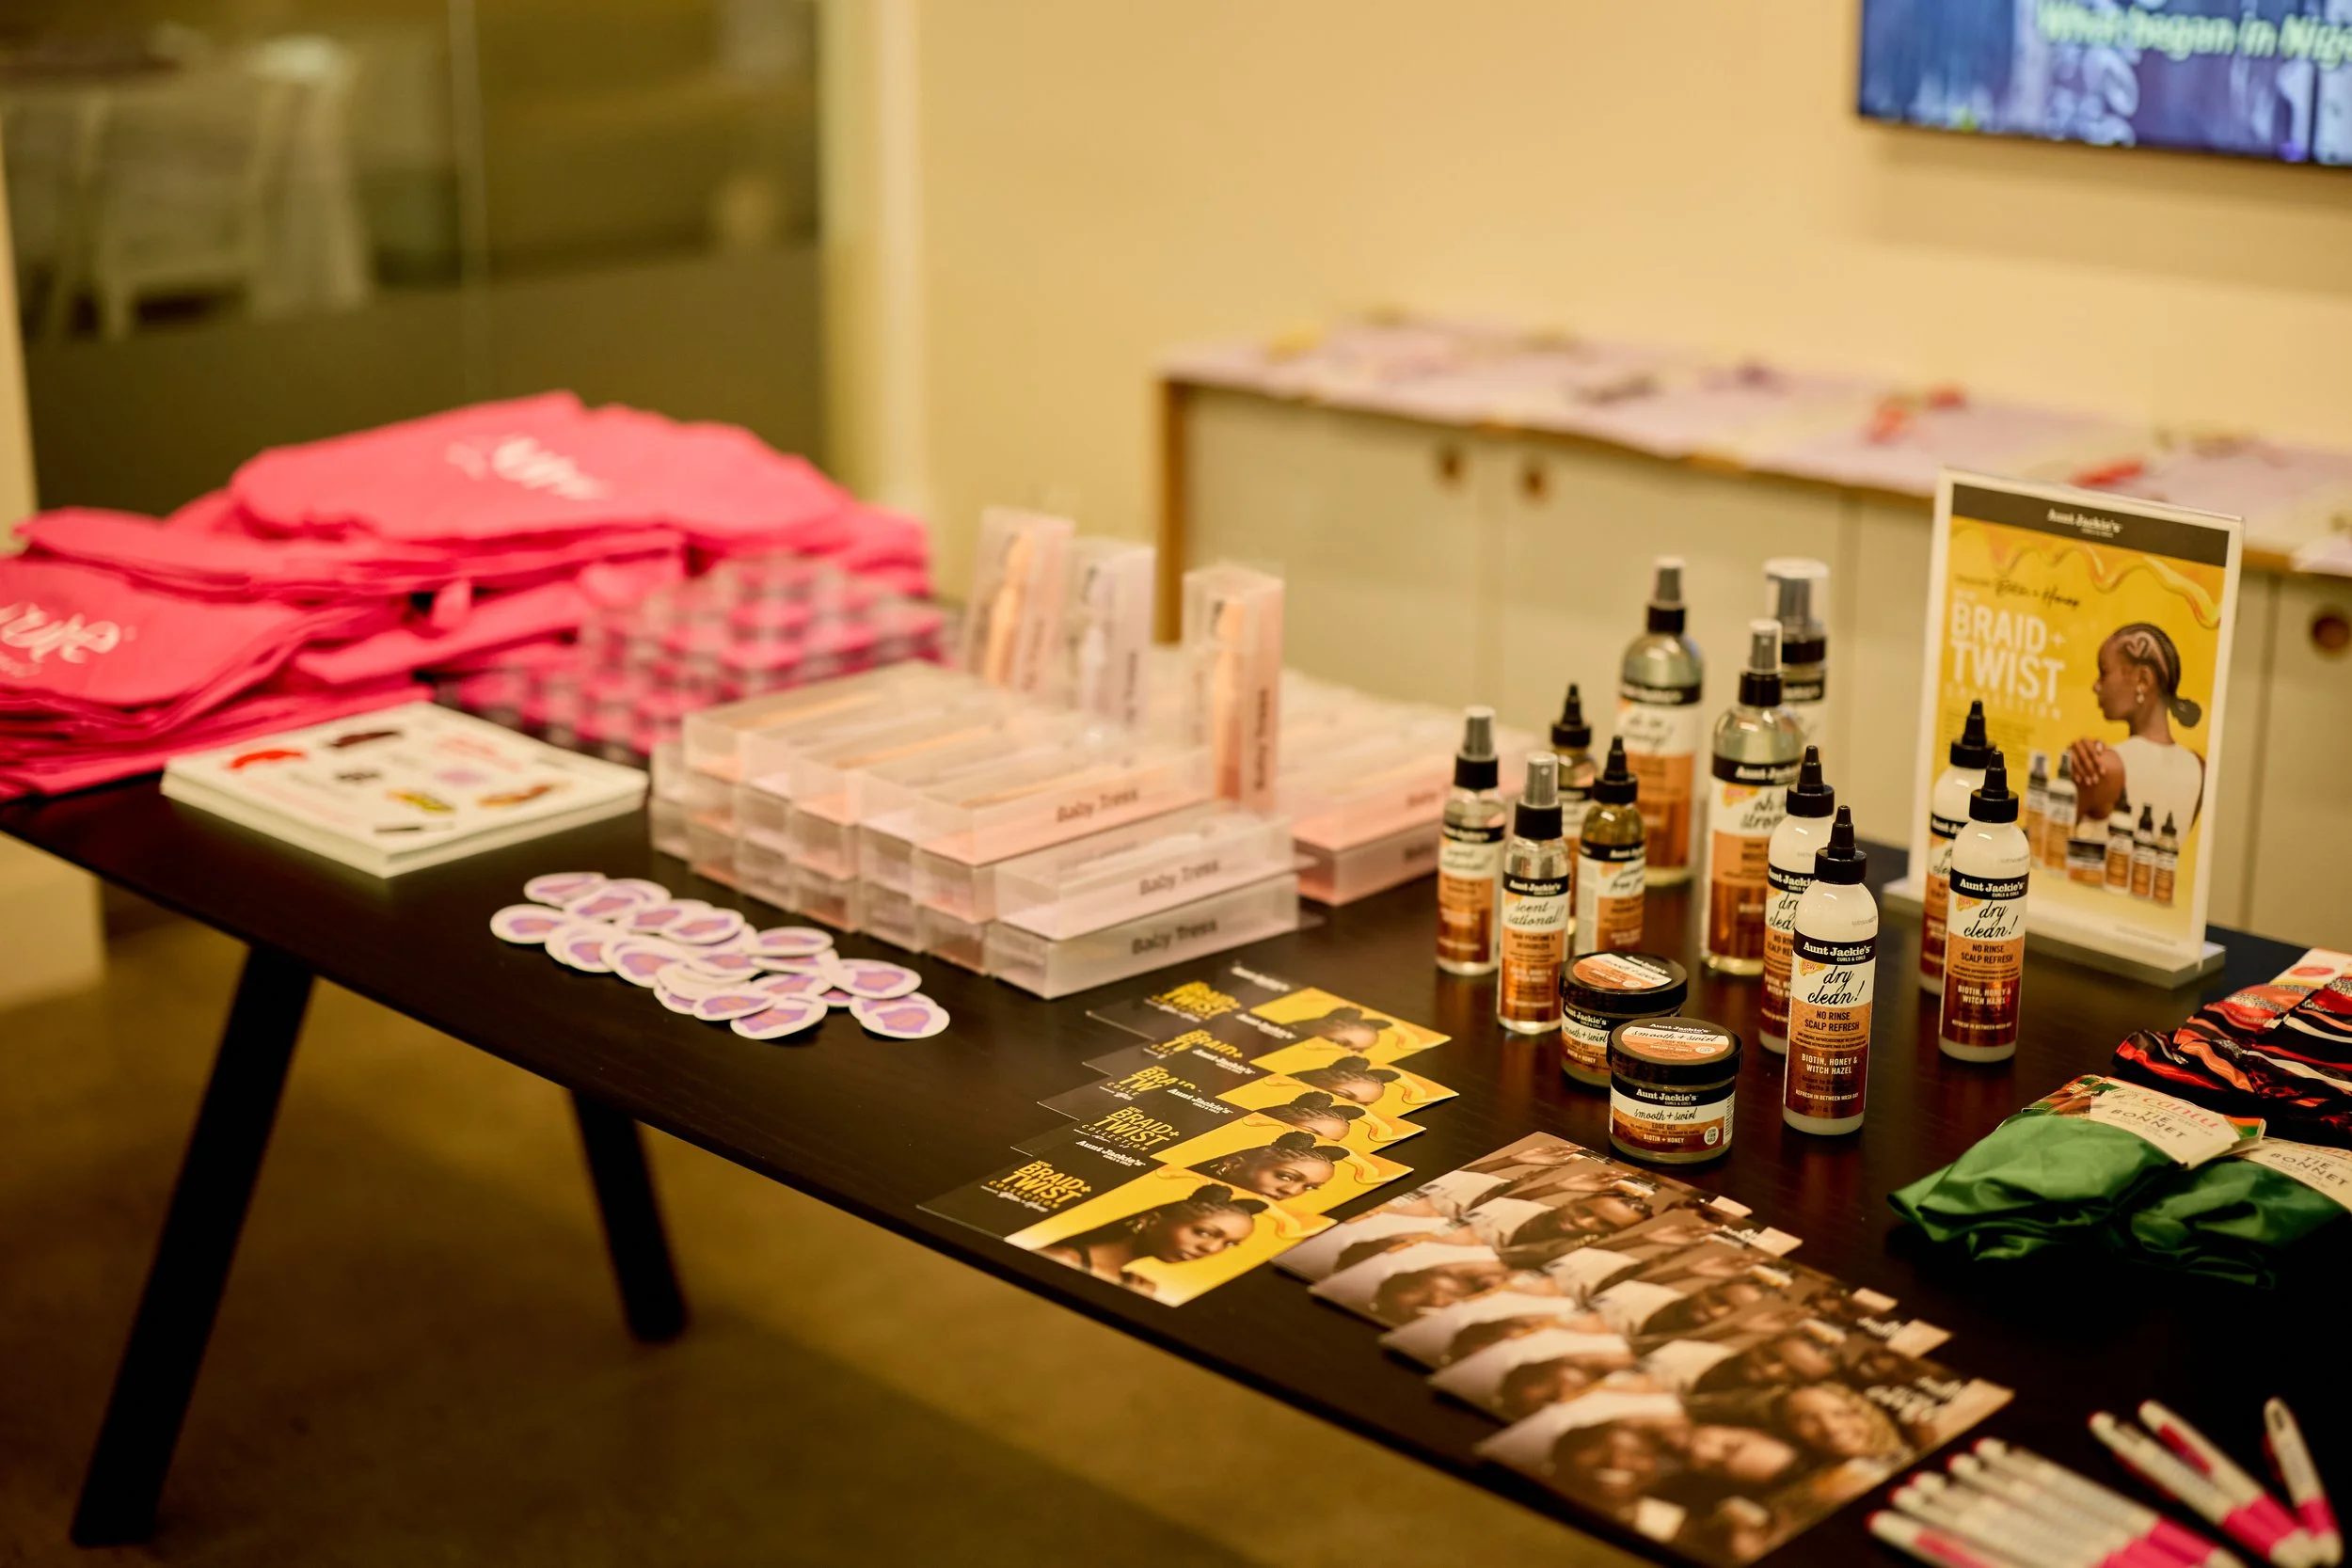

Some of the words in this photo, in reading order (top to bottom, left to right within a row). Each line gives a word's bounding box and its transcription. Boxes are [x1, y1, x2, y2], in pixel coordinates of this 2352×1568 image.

[1950, 640, 2066, 705] TWIST
[1960, 878, 1984, 892] Aunt
[1985, 881, 2024, 893] Jackie's
[1979, 900, 2009, 929] dry
[1963, 915, 2019, 939] clean!
[1803, 942, 1829, 956] Aunt
[1829, 945, 1870, 958] Jackie's
[1972, 943, 1981, 953] NO
[1984, 945, 2005, 954] RINSE
[1961, 952, 1982, 963] SCALP
[1983, 954, 2013, 964] REFRESH
[1822, 965, 1855, 994] dry
[1807, 980, 1866, 1005] clean!
[1963, 995, 1984, 1006] WITCH
[1576, 1011, 1607, 1025] Jackie's
[1816, 1010, 1826, 1021] NO
[1828, 1011, 1851, 1021] RINSE
[1804, 1019, 1826, 1031] SCALP
[1828, 1022, 1860, 1032] REFRESH
[1631, 1030, 1675, 1039] smooth
[1687, 1034, 1720, 1042] swirl
[1192, 1049, 1216, 1062] Aunt
[1215, 1057, 1256, 1075] Jackie's
[1802, 1053, 1827, 1066] BIOTIN,
[1829, 1056, 1851, 1066] HONEY
[1806, 1064, 1829, 1075] WITCH
[1831, 1066, 1852, 1075] HAZEL
[1636, 1088, 1658, 1101] Aunt
[1659, 1092, 1697, 1102] Jackie's
[1795, 1088, 1813, 1099] REFRESH
[1167, 1088, 1194, 1101] Aunt
[1192, 1097, 1234, 1115] Jackie's
[1634, 1108, 1665, 1121] smooth
[1674, 1107, 1697, 1121] swirl
[2142, 1097, 2218, 1129] cantu
[2144, 1110, 2172, 1124] TIE
[1093, 1115, 1170, 1147] TWIST
[2110, 1109, 2187, 1138] BONNET
[1081, 1123, 1150, 1152] COLLECTION
[1644, 1133, 1661, 1142] BIOTIN
[1075, 1140, 1104, 1152] Aunt
[1101, 1147, 1147, 1166] Jackie's
[2269, 1152, 2350, 1186] BONNET
[2304, 1156, 2333, 1170] TIE
[1000, 1170, 1083, 1204] TWIST
